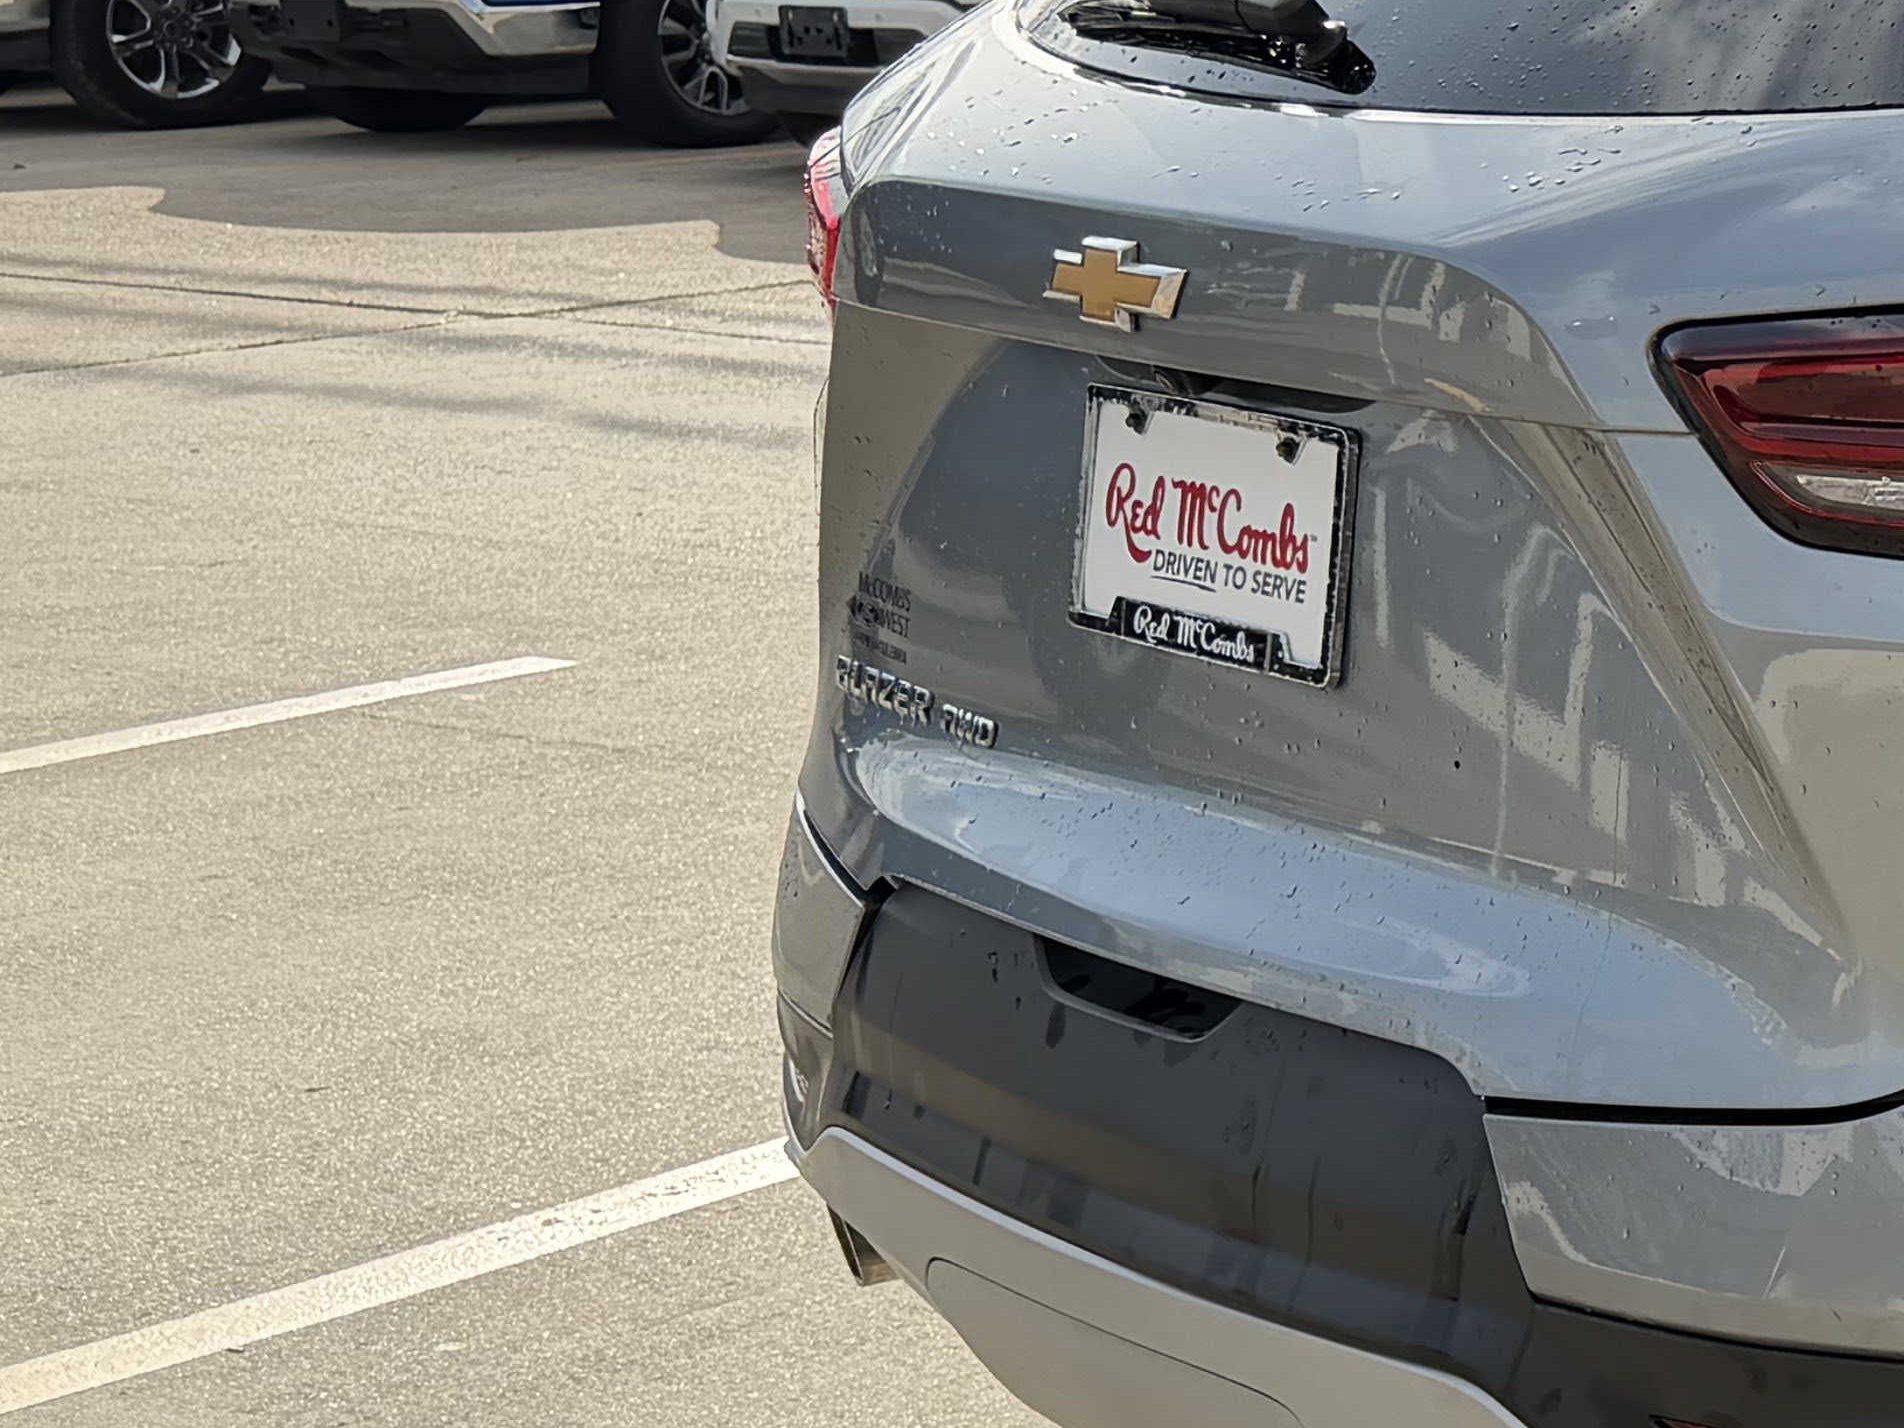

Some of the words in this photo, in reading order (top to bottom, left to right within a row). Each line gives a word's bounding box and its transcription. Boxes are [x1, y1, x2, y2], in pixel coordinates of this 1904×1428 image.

[1105, 462, 1166, 564] Red
[1152, 549, 1219, 585] DRIVEN
[1222, 563, 1247, 590] TO
[1251, 573, 1308, 604] SERVE
[1133, 605, 1170, 645] Red
[836, 655, 936, 727] BLAZER
[941, 703, 999, 749] AWD
